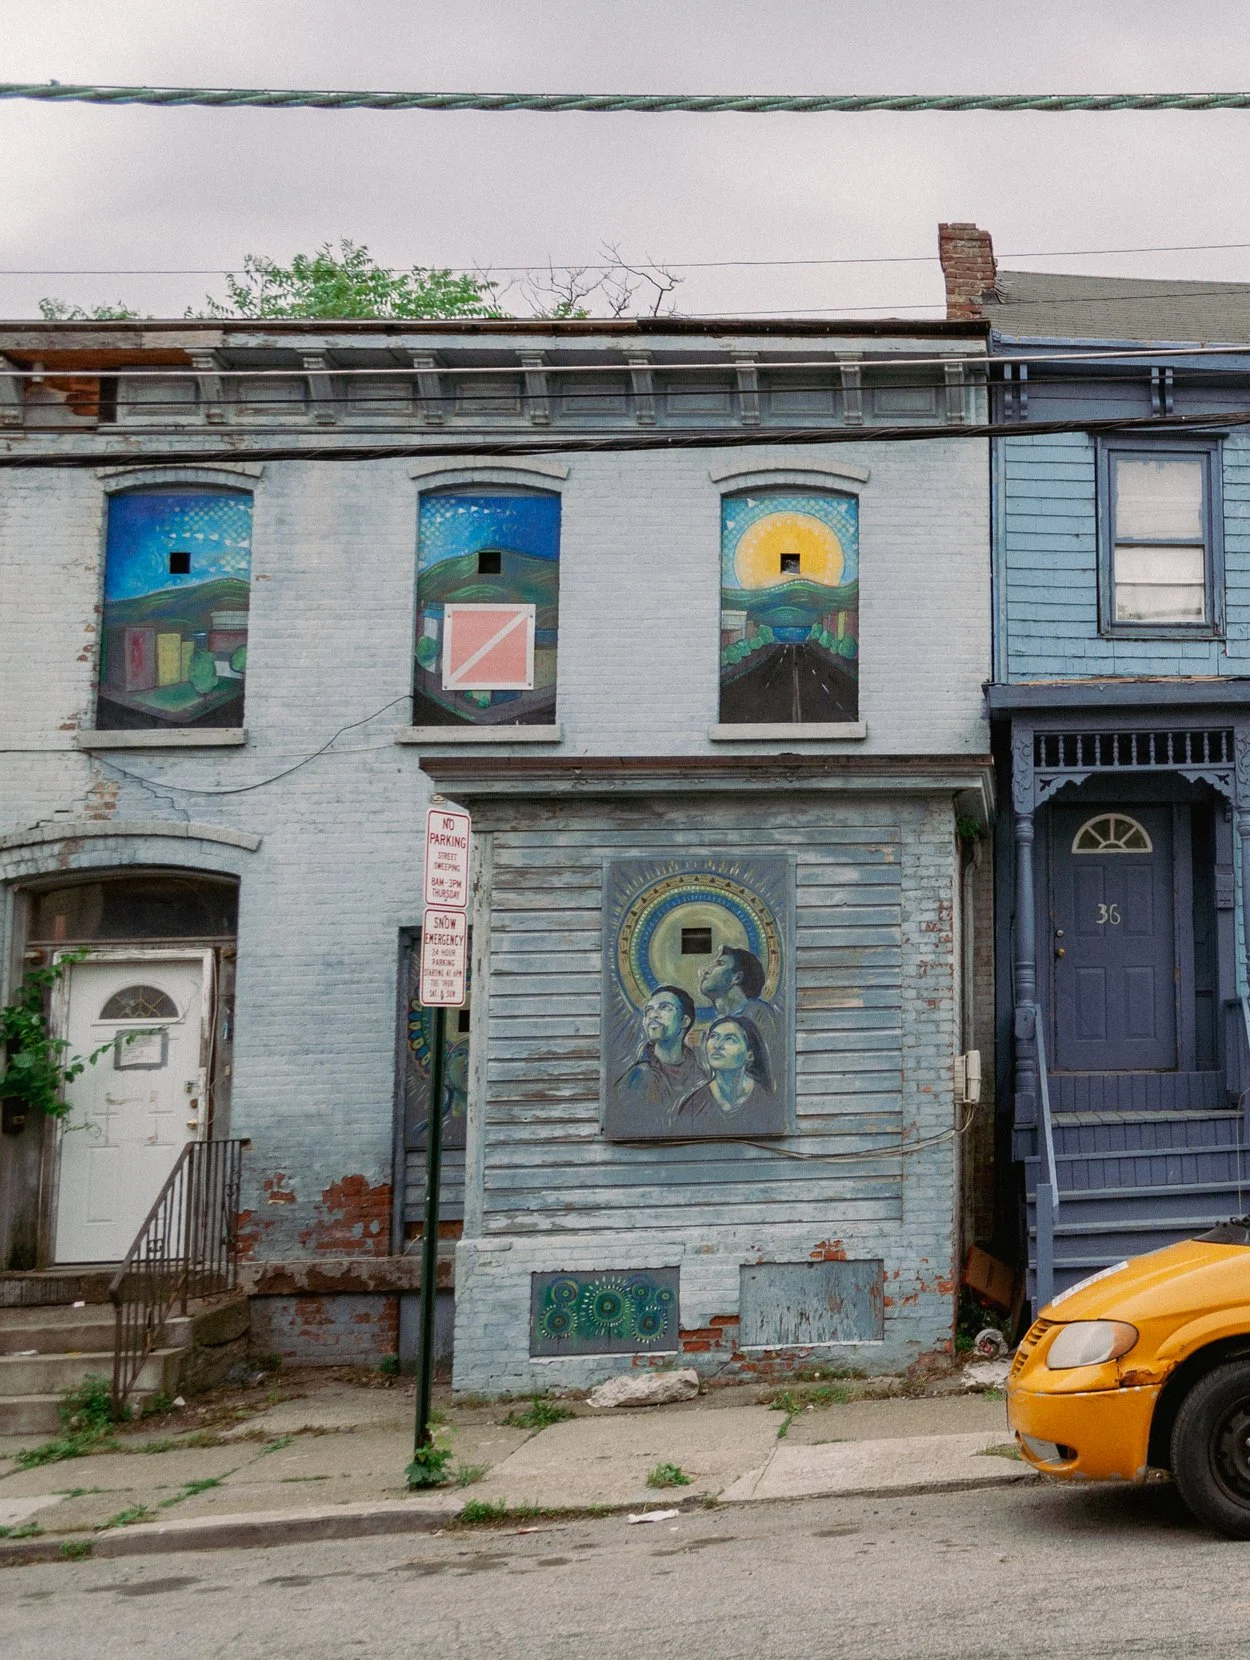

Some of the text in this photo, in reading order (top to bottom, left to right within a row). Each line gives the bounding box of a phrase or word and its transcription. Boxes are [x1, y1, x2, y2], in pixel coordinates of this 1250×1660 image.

[442, 817, 455, 831] NO
[429, 832, 466, 849] PARKING
[437, 851, 458, 861] STREET
[433, 862, 461, 872] SWEEPING
[431, 877, 462, 888] 8AM-3PM
[432, 888, 461, 899] THURSDAY
[1096, 903, 1121, 925] 36
[433, 916, 457, 930] SNOW
[424, 932, 464, 946] EMERGENCY
[431, 948, 456, 957] 24 HOUR
[431, 958, 455, 967] PARKING
